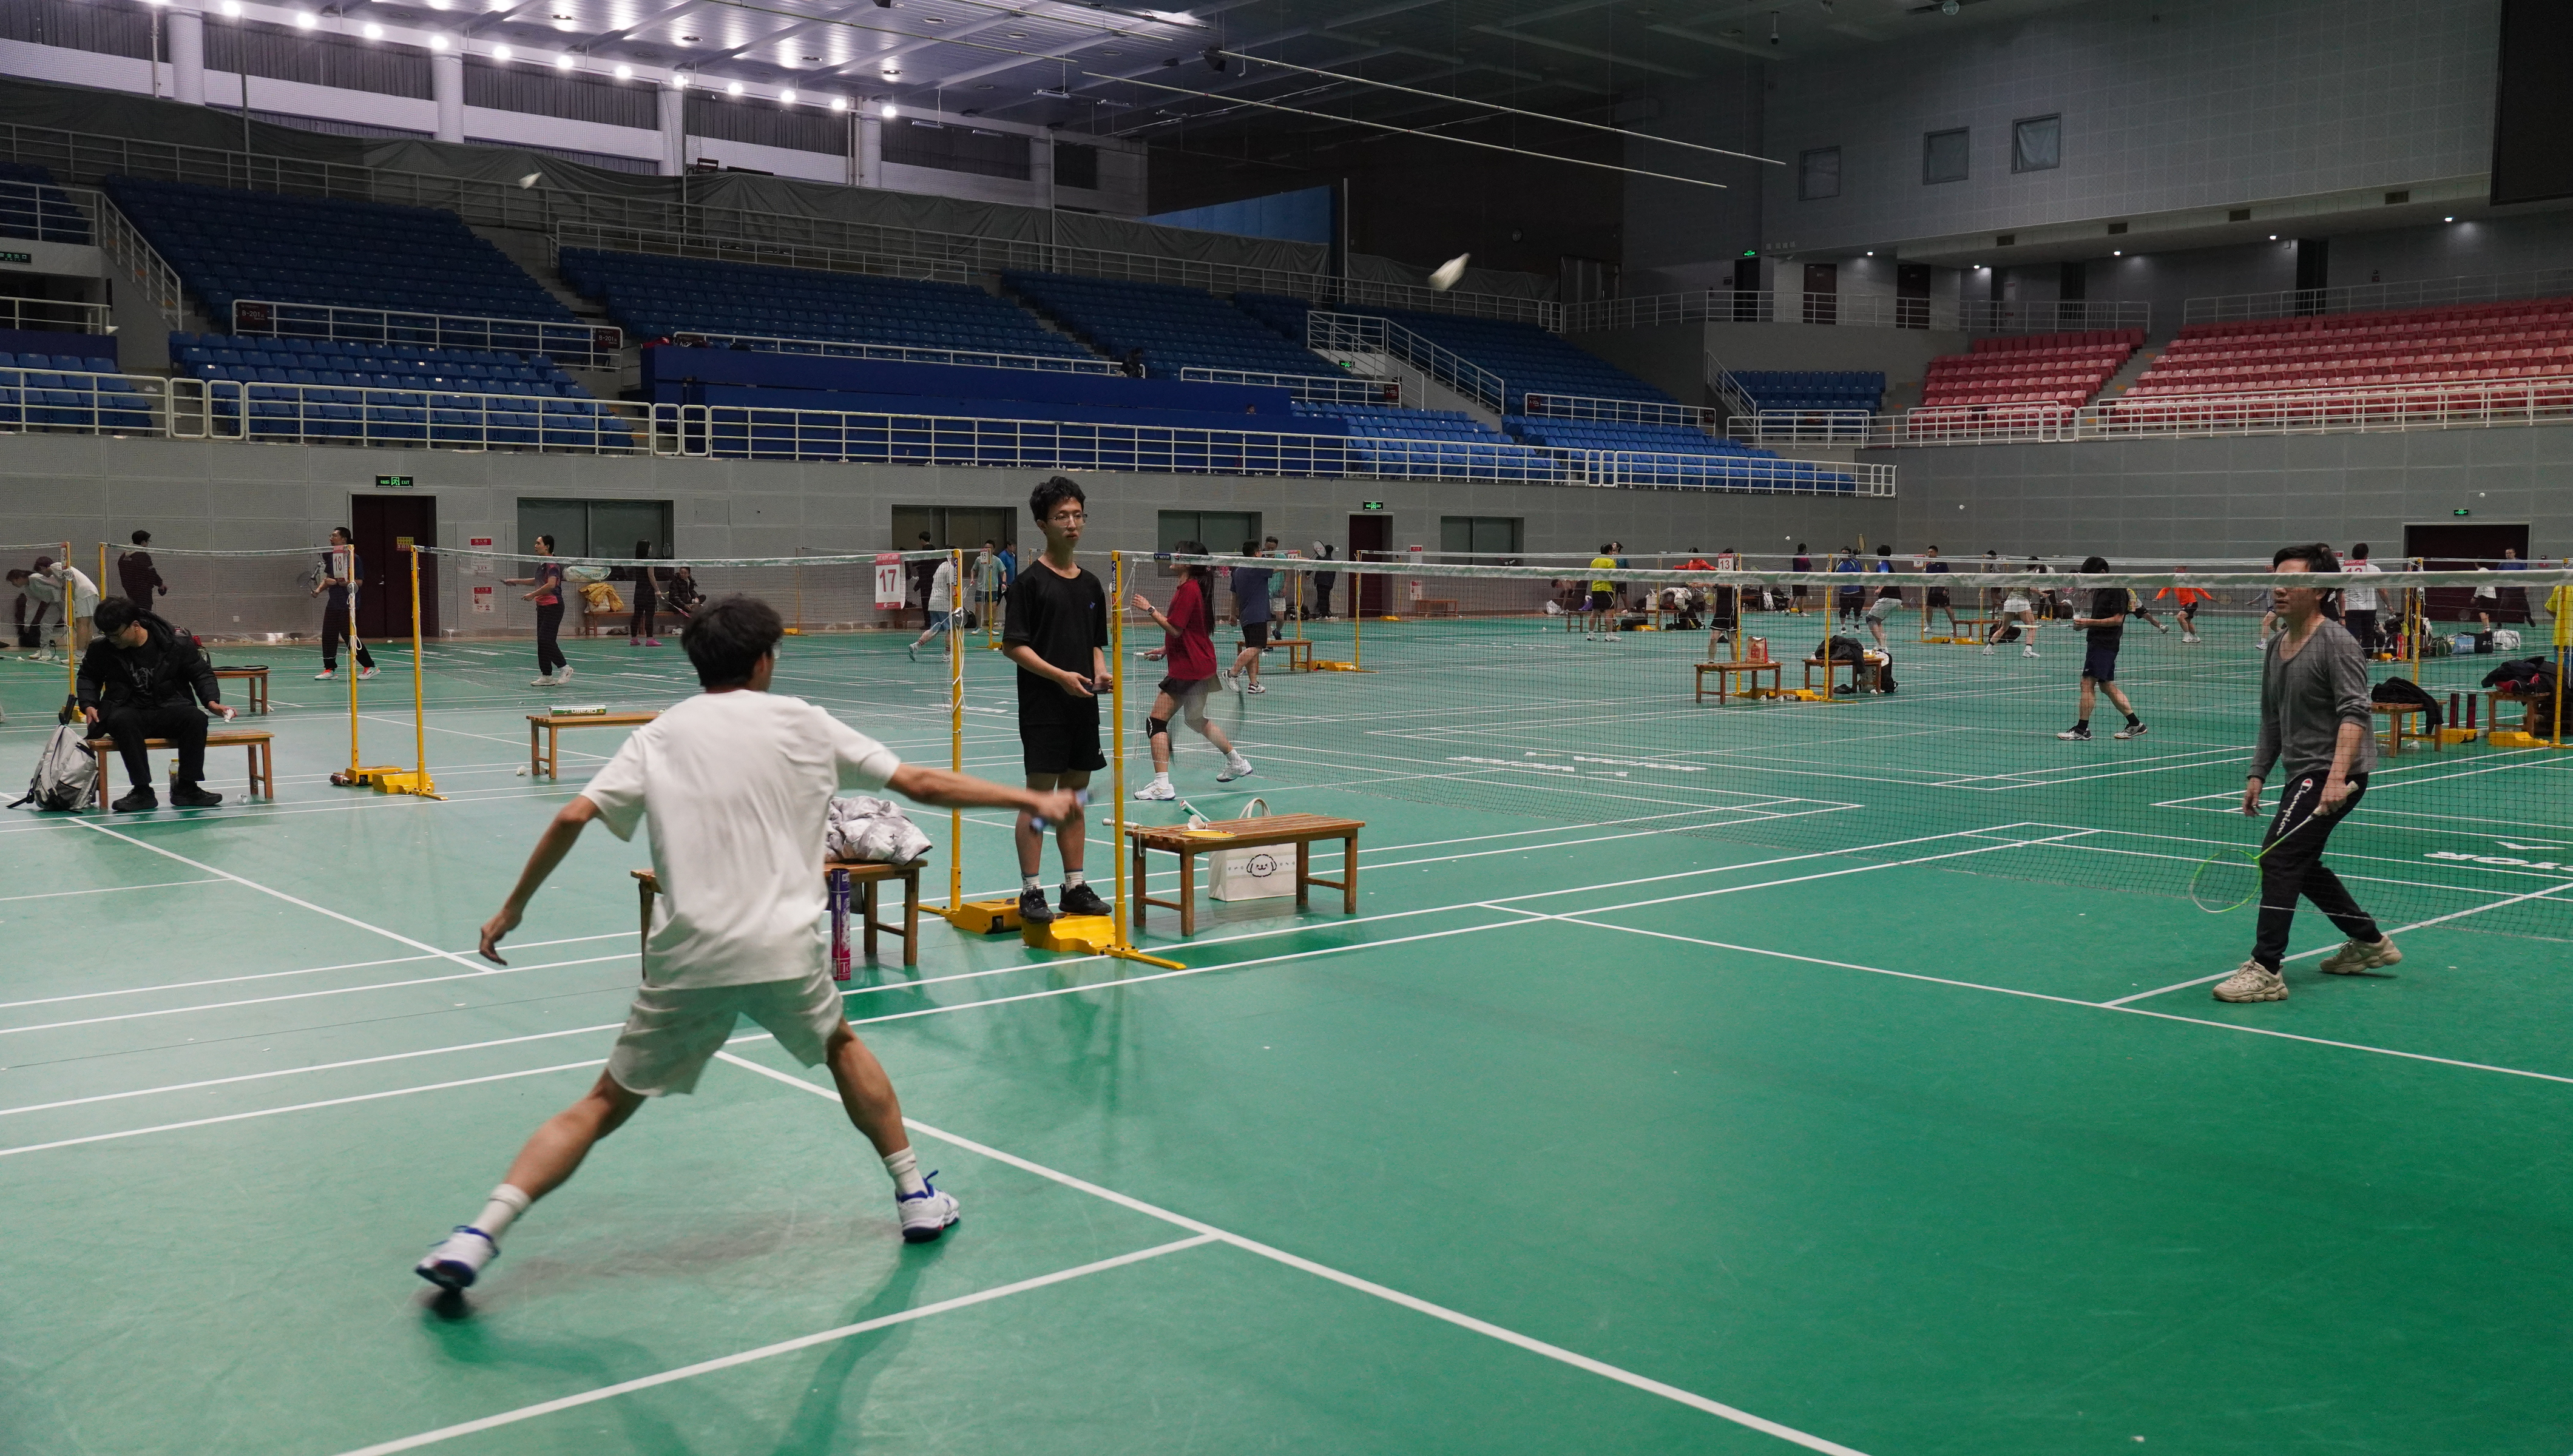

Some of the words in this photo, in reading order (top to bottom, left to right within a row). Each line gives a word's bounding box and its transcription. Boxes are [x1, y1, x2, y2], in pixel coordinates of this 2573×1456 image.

[334, 556, 342, 571] 18
[1720, 559, 1730, 569] 13
[879, 569, 896, 592] 17
[2276, 778, 2313, 836] Champion
